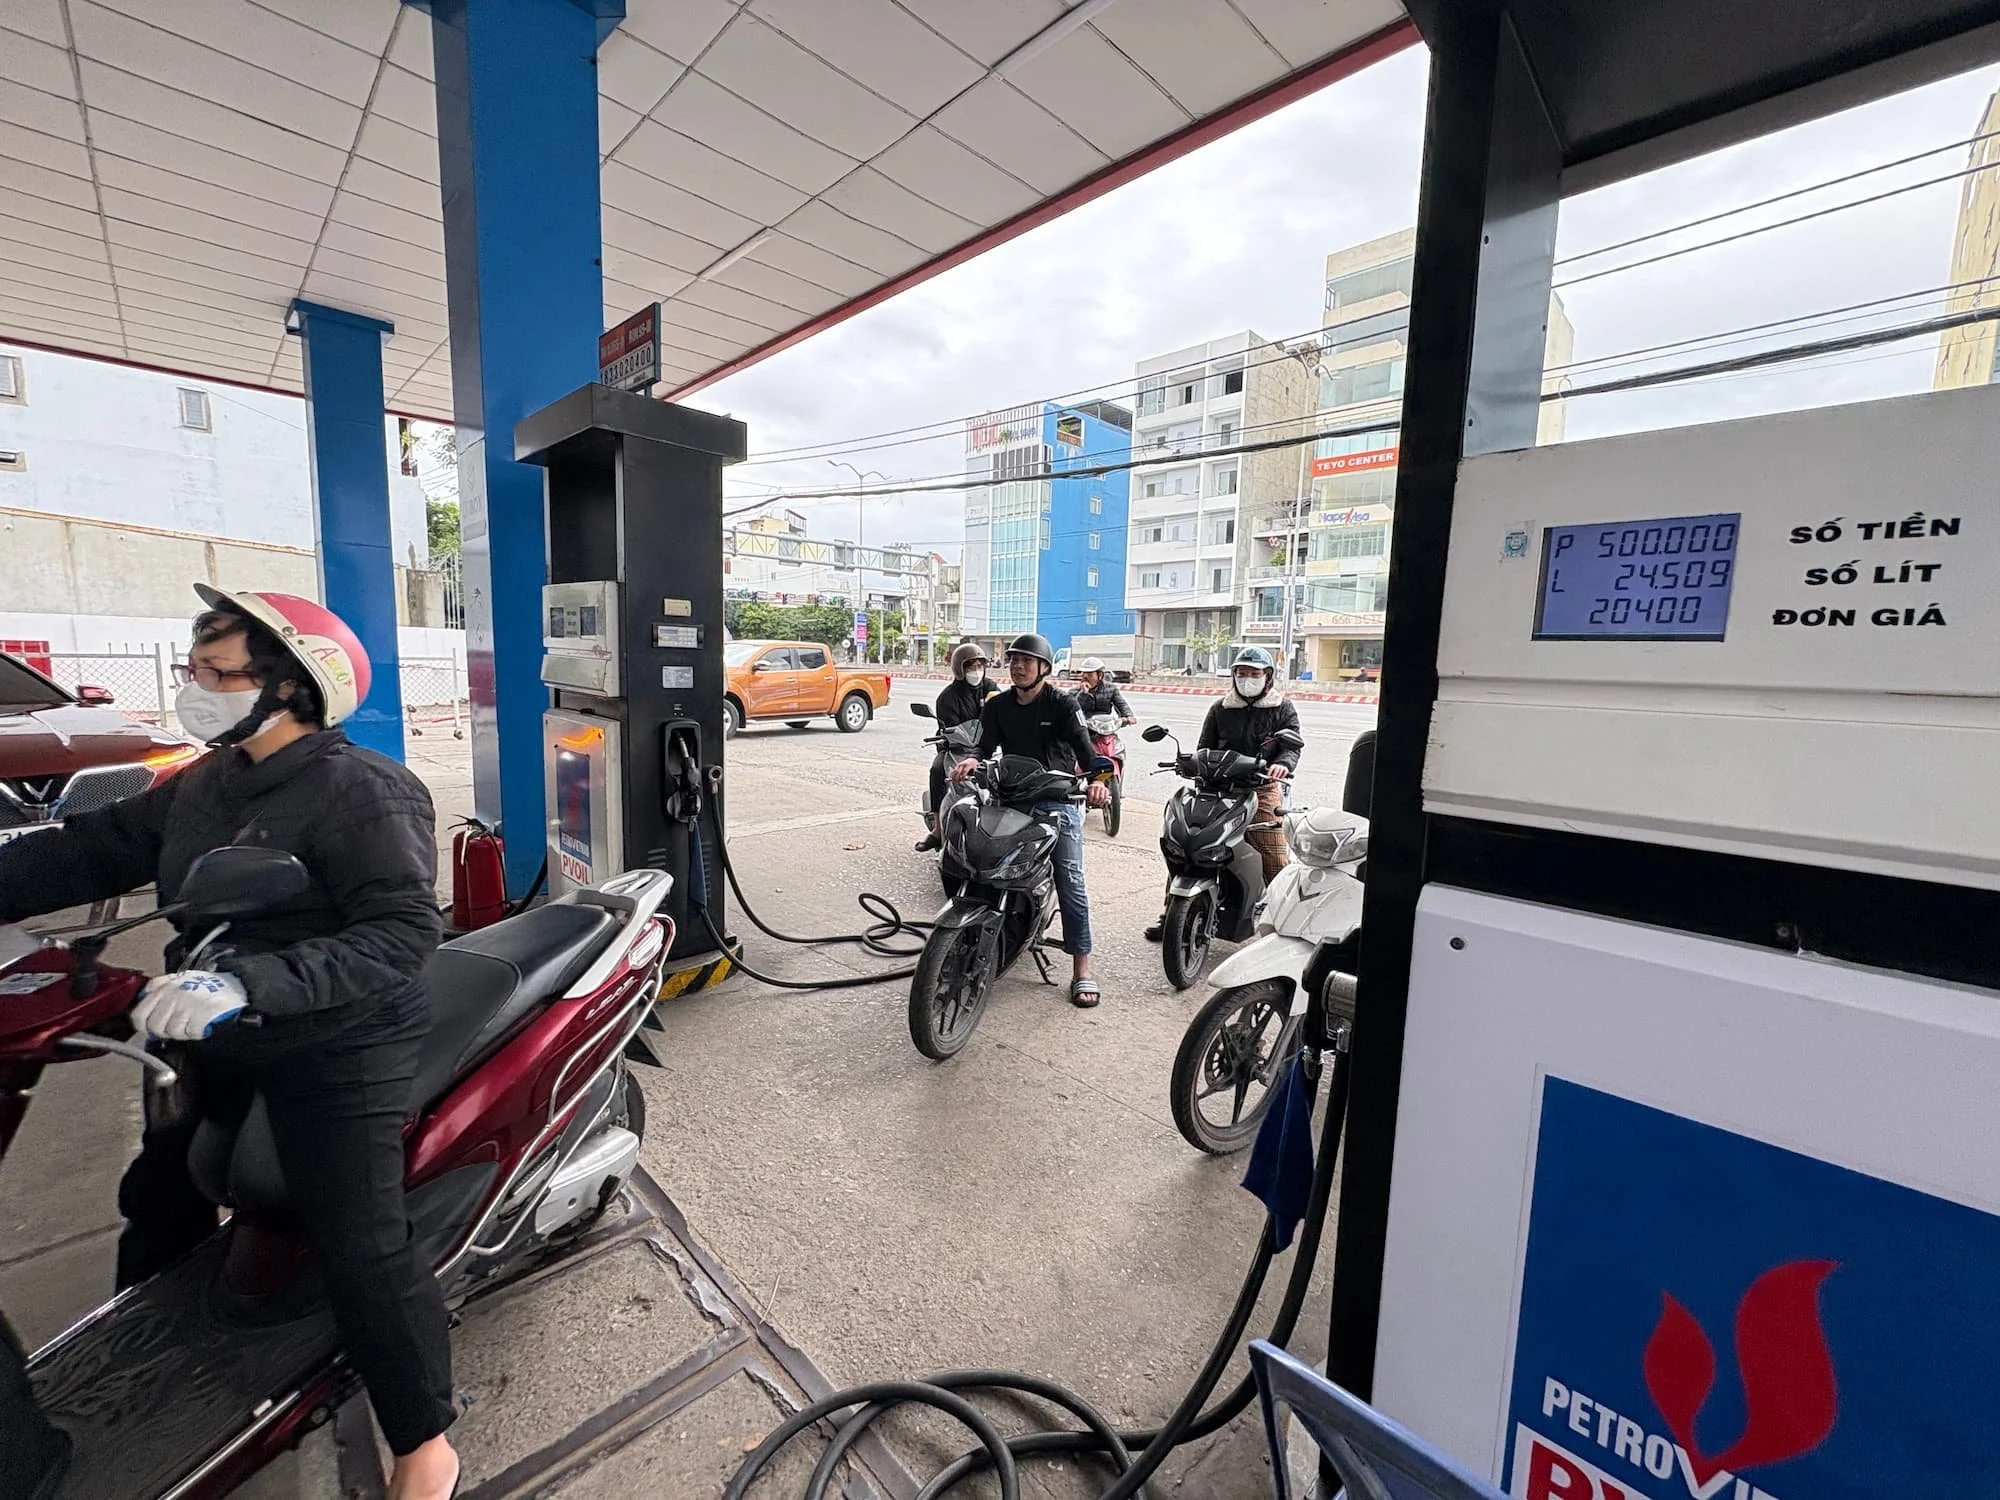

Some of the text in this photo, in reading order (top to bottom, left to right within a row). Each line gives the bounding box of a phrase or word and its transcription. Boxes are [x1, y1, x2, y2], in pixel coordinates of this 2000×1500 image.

[1317, 453, 1394, 471] TEYO CENTER
[1555, 534, 1574, 558] P
[1598, 523, 1736, 558] 500.000
[1789, 511, 1961, 544] SỐ TIỀN
[1552, 560, 1731, 592] L 24.509
[1804, 560, 1942, 585] SỐ LÍT
[1589, 596, 1702, 624] 20400
[1772, 602, 1947, 626] ĐƠN GIÁ
[562, 854, 591, 885] PVOIL
[1542, 1376, 1780, 1500] PETROV
